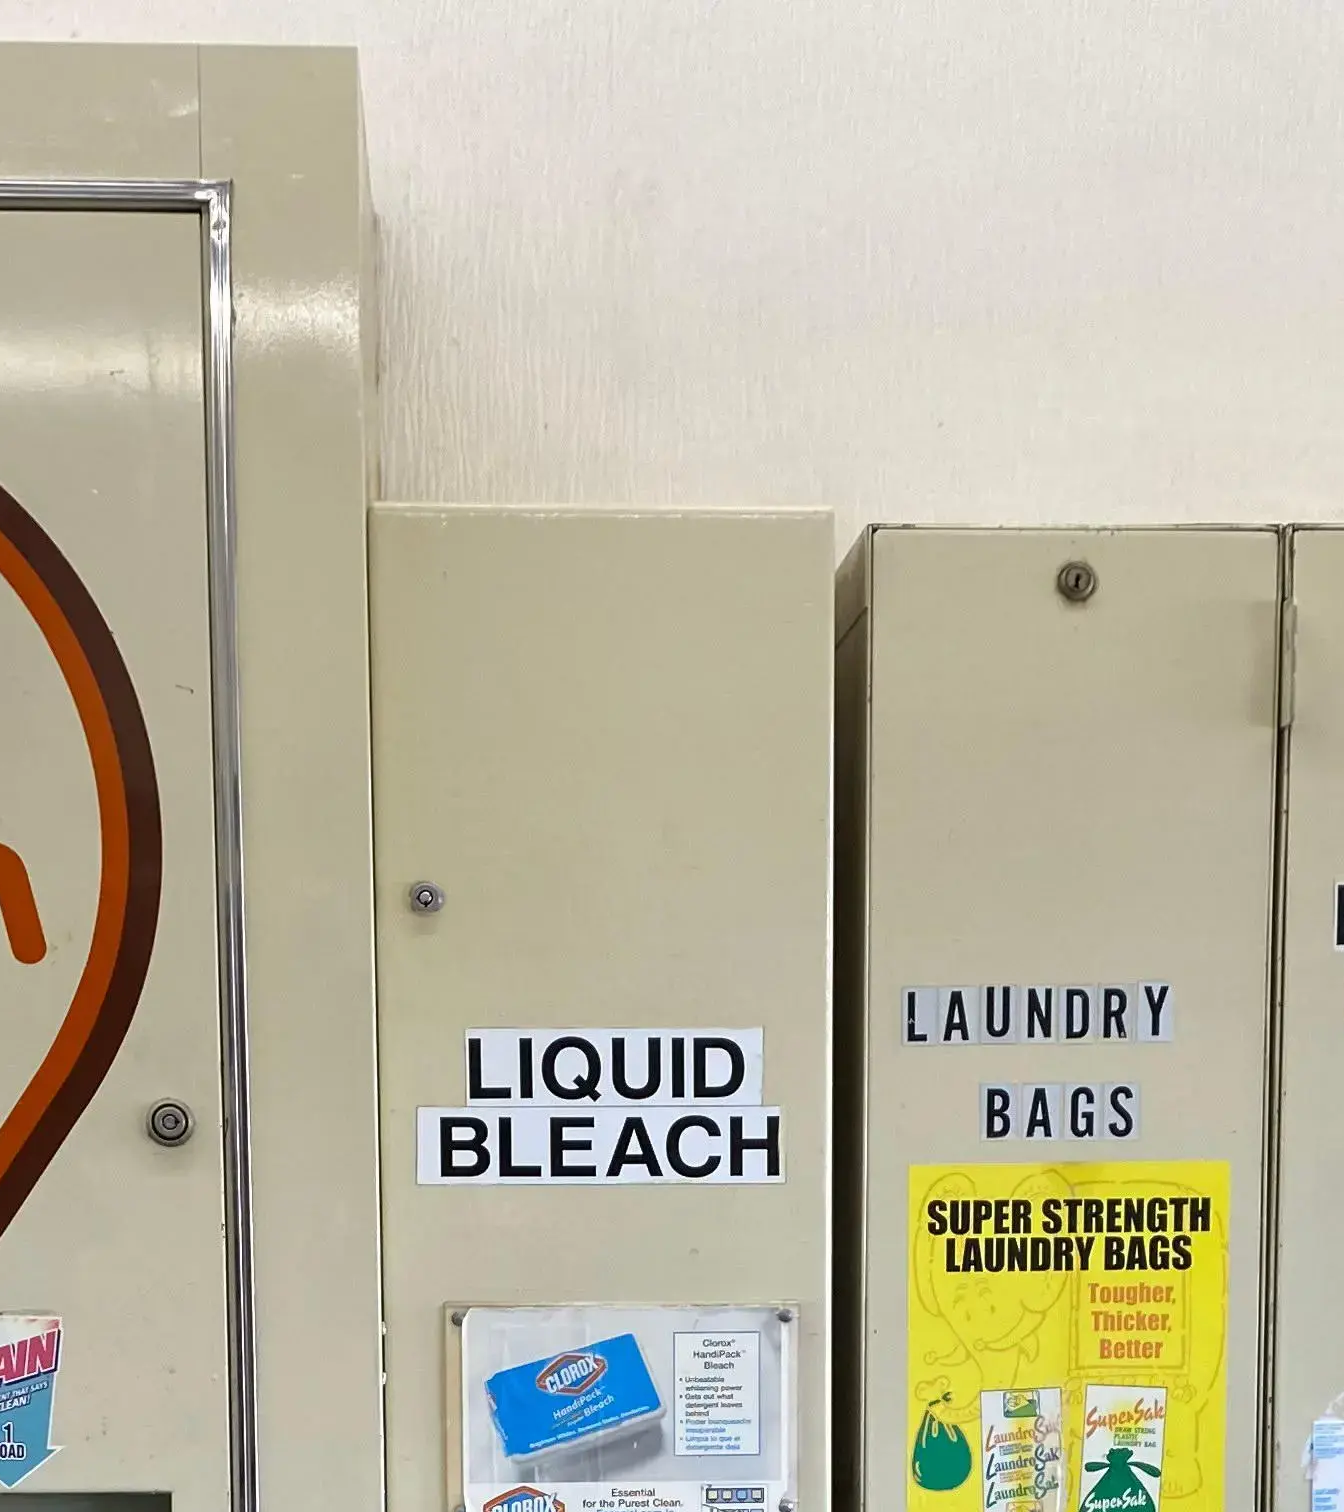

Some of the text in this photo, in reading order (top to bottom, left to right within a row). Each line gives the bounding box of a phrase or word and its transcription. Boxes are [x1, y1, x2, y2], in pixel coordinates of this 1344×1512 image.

[906, 984, 1169, 1042] LAUNDRY
[468, 1036, 746, 1102] LIQUID
[986, 1086, 1135, 1138] BAGS
[439, 1115, 781, 1178] BLEACH
[926, 1196, 1212, 1236] SUPER STRENGTH
[945, 1234, 1193, 1273] LAUNDRY BAGS
[1088, 1282, 1176, 1306] Tougher,
[1090, 1310, 1172, 1333] Thicker,
[704, 1360, 734, 1371] Bleach
[1098, 1340, 1164, 1359] Better
[545, 1353, 599, 1395] CLOROX
[1085, 1398, 1166, 1439] SuperSak
[582, 1499, 684, 1509] for the Purest Clean.
[610, 1488, 656, 1498] Essential
